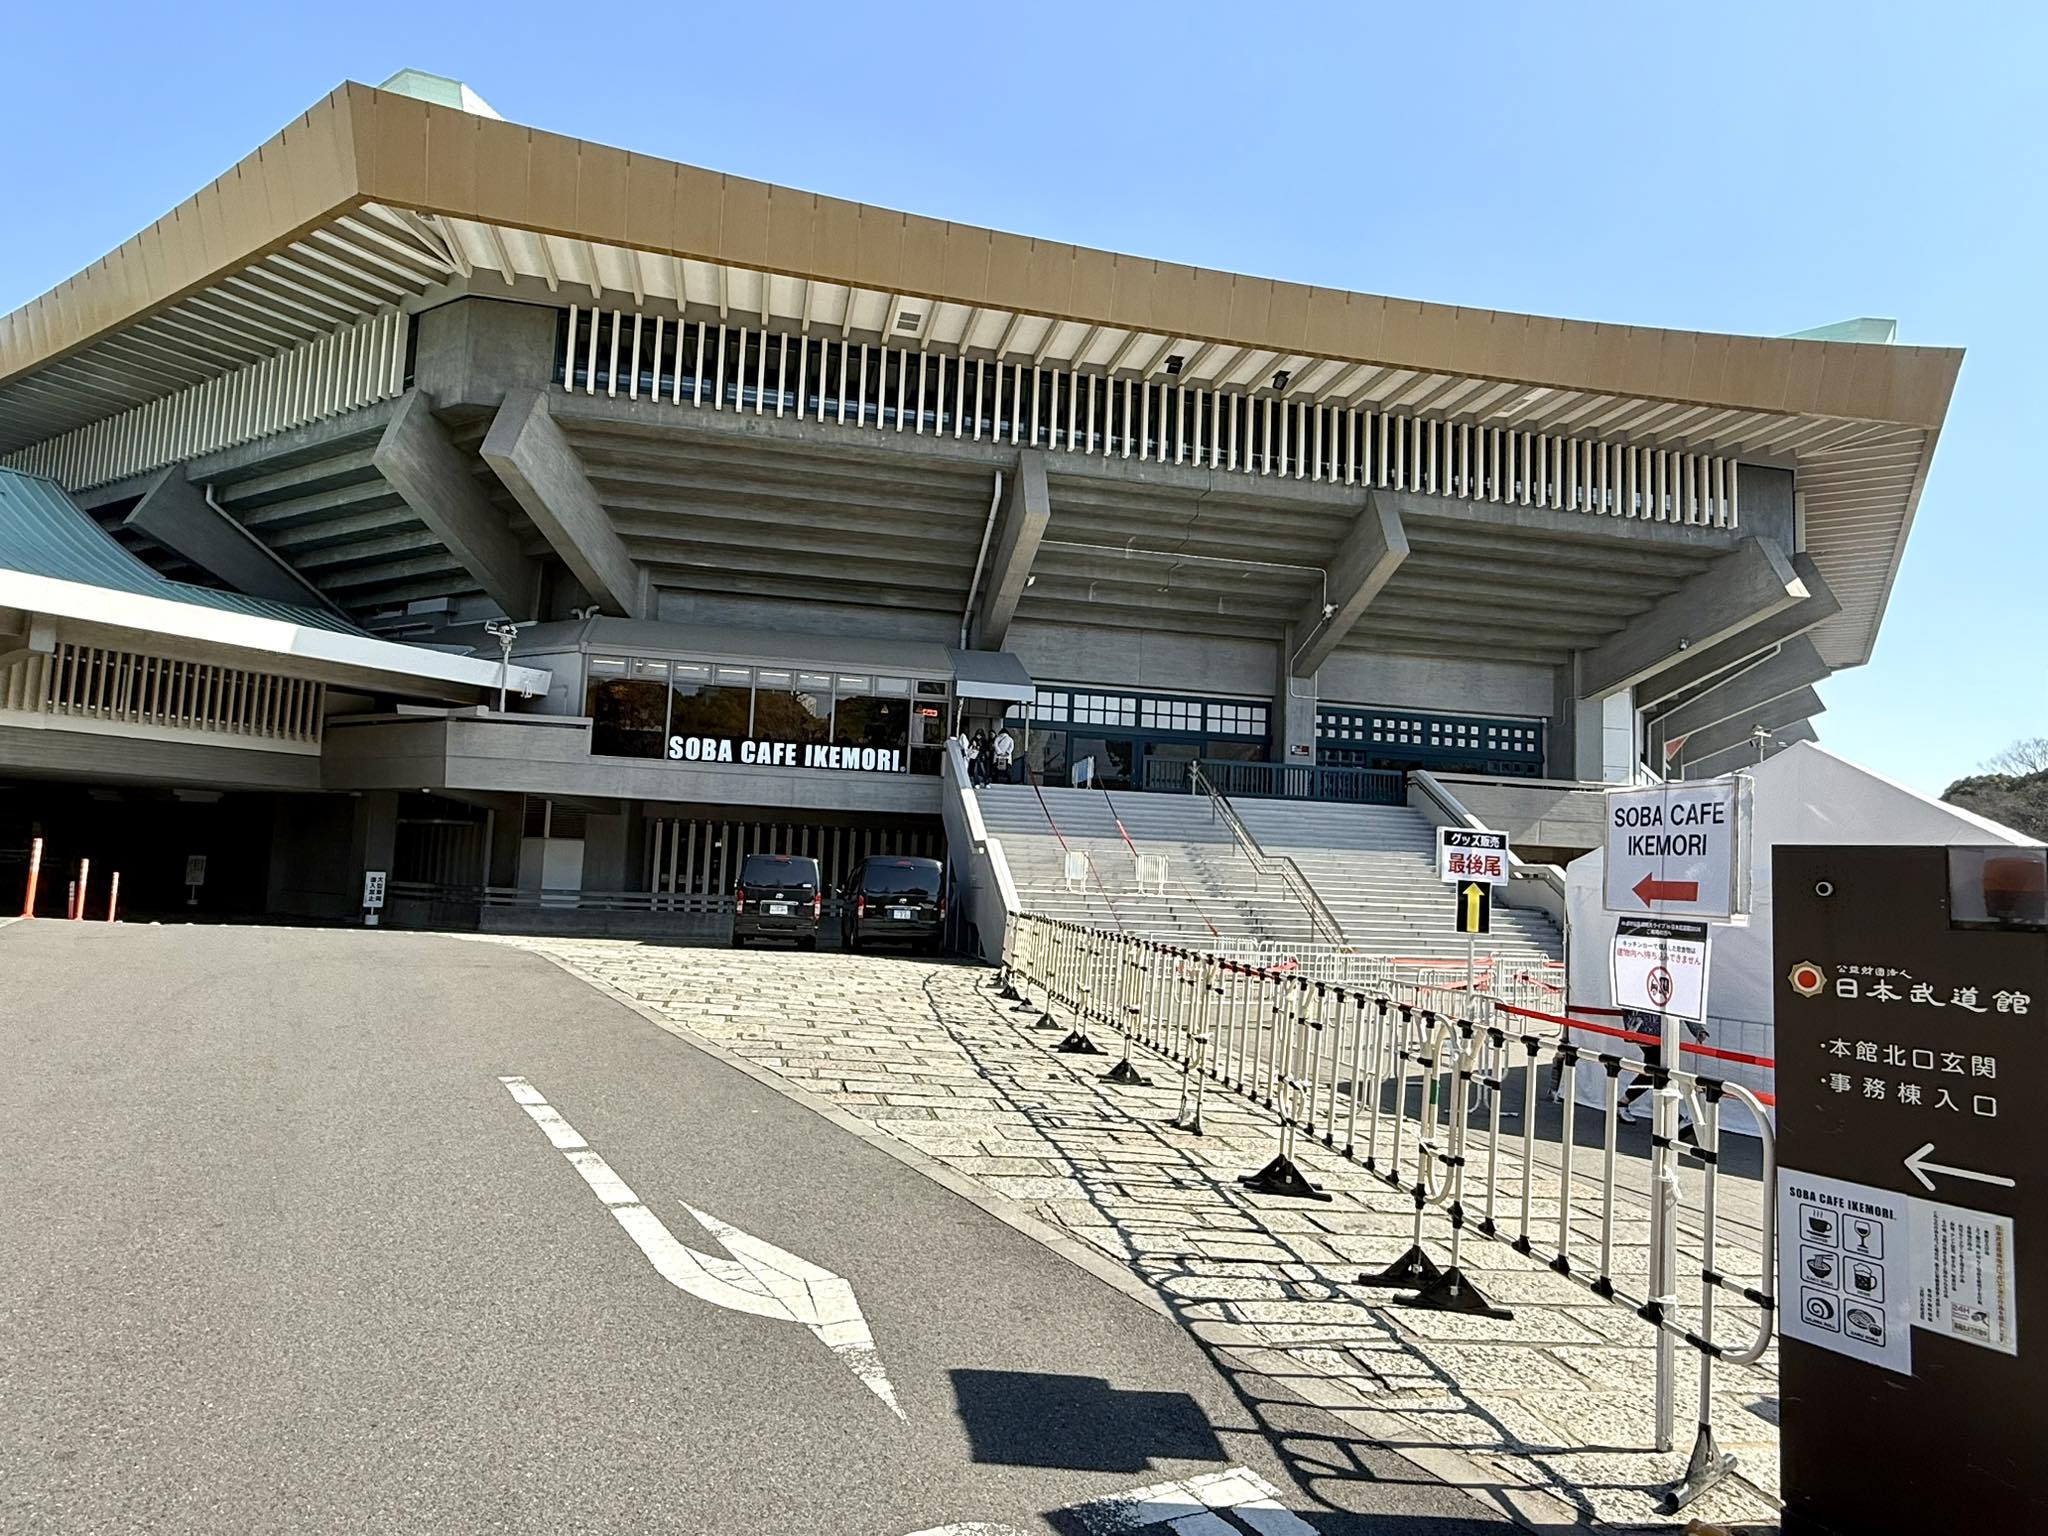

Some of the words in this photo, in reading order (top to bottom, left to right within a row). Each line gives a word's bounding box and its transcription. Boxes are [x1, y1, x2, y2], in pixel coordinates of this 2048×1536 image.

[669, 735, 733, 762] SOBA
[741, 740, 797, 766] CAFE
[804, 744, 900, 772] IKEMORI
[1614, 806, 1663, 827] SOBA
[1671, 802, 1724, 826] CAFE
[1451, 833, 1500, 848] グッズ販売
[1628, 834, 1707, 856] IKEMORI
[1448, 852, 1501, 876] 最後尾
[1836, 978, 2031, 1015] 日本武道館
[1789, 1186, 1817, 1202] SOBA
[1819, 1193, 1845, 1209] CAFE
[1847, 1199, 1894, 1220] IKEMORI
